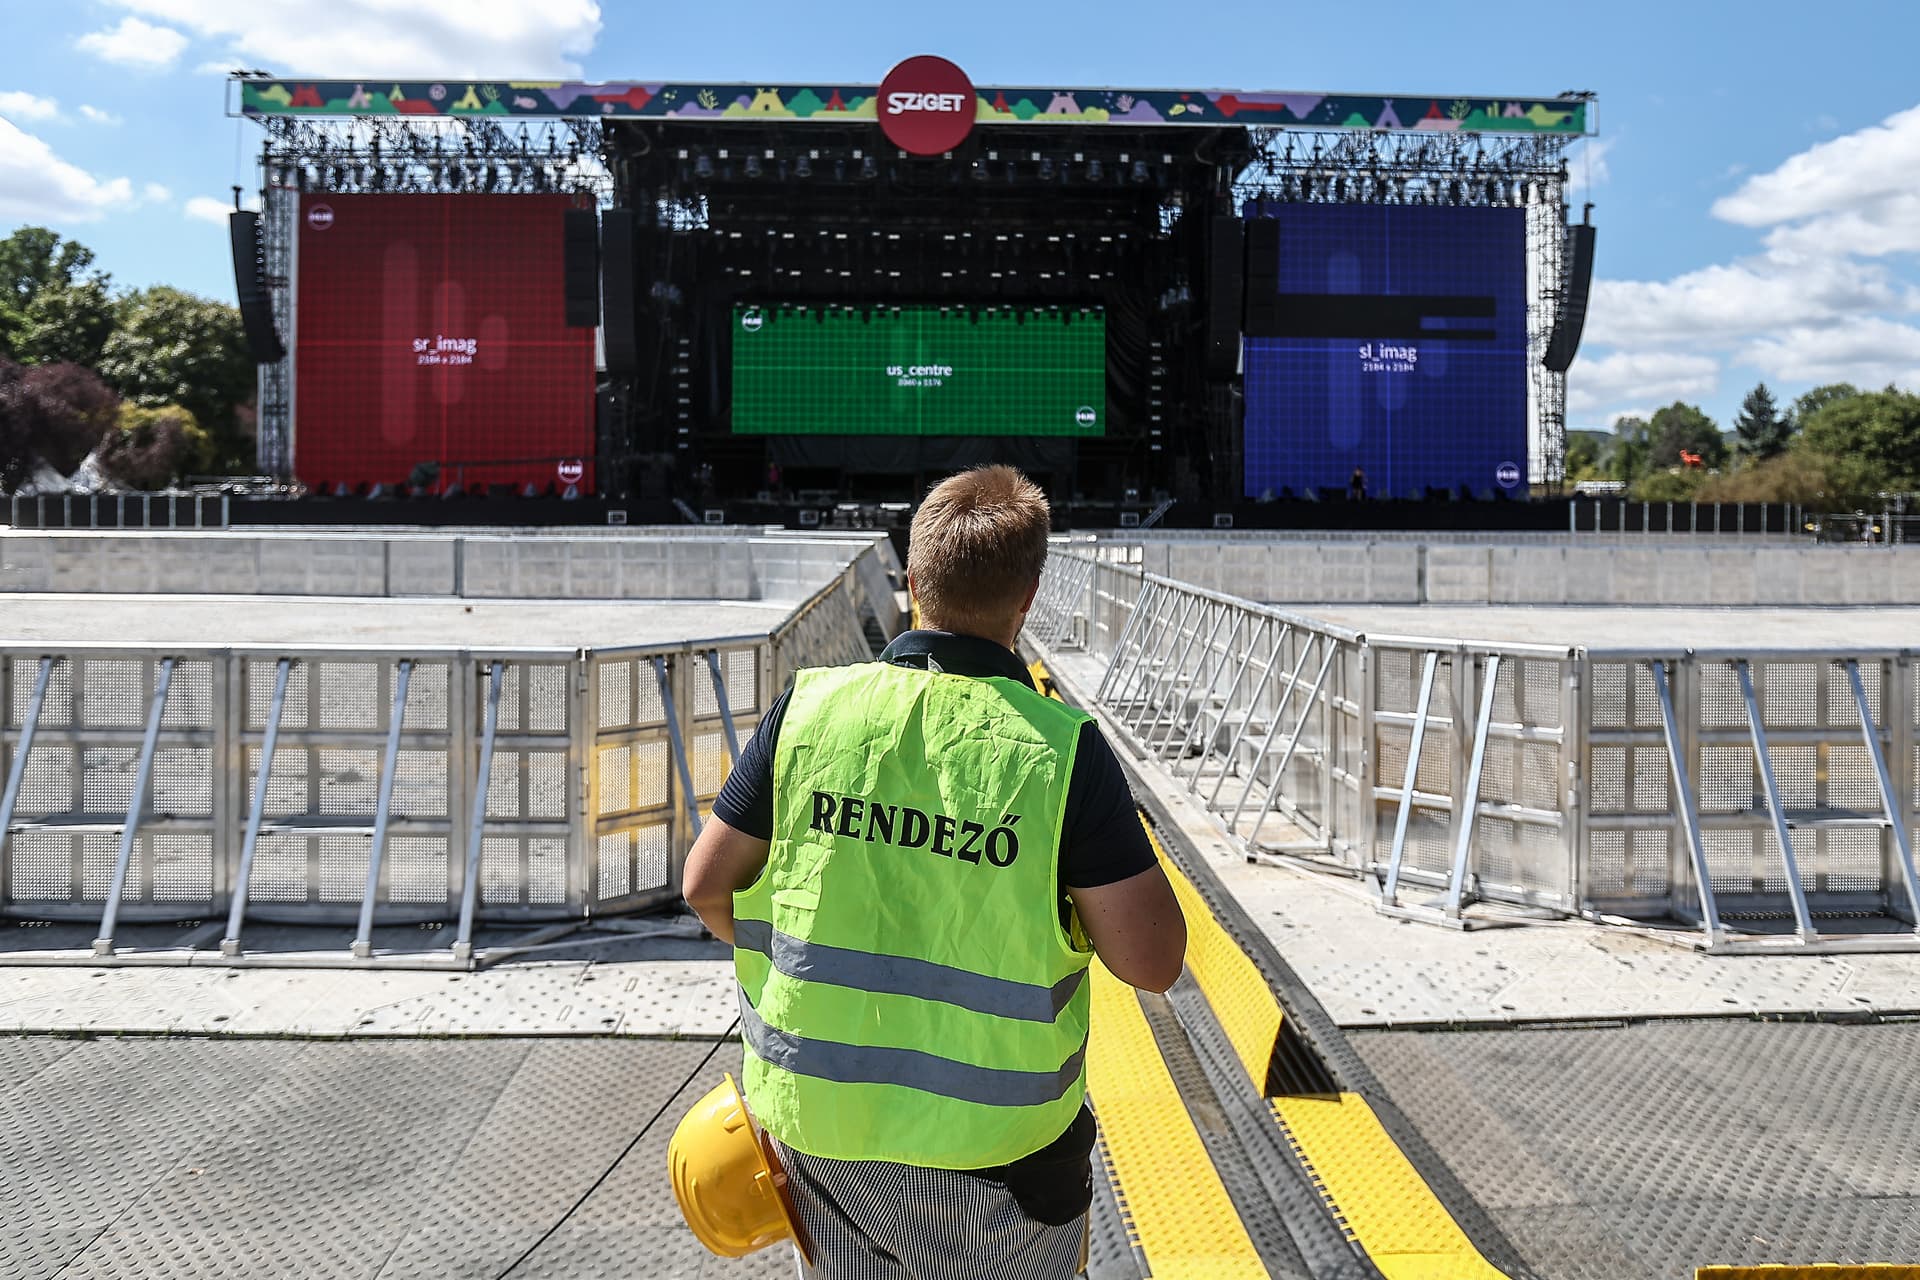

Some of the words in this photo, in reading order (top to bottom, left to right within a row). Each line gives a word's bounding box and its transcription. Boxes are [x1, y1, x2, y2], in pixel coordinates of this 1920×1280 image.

[413, 335, 477, 355] sr_imag
[1359, 343, 1417, 362] sl_imag
[886, 365, 952, 378] us_centre
[810, 791, 1022, 867] RENDEZŐ
